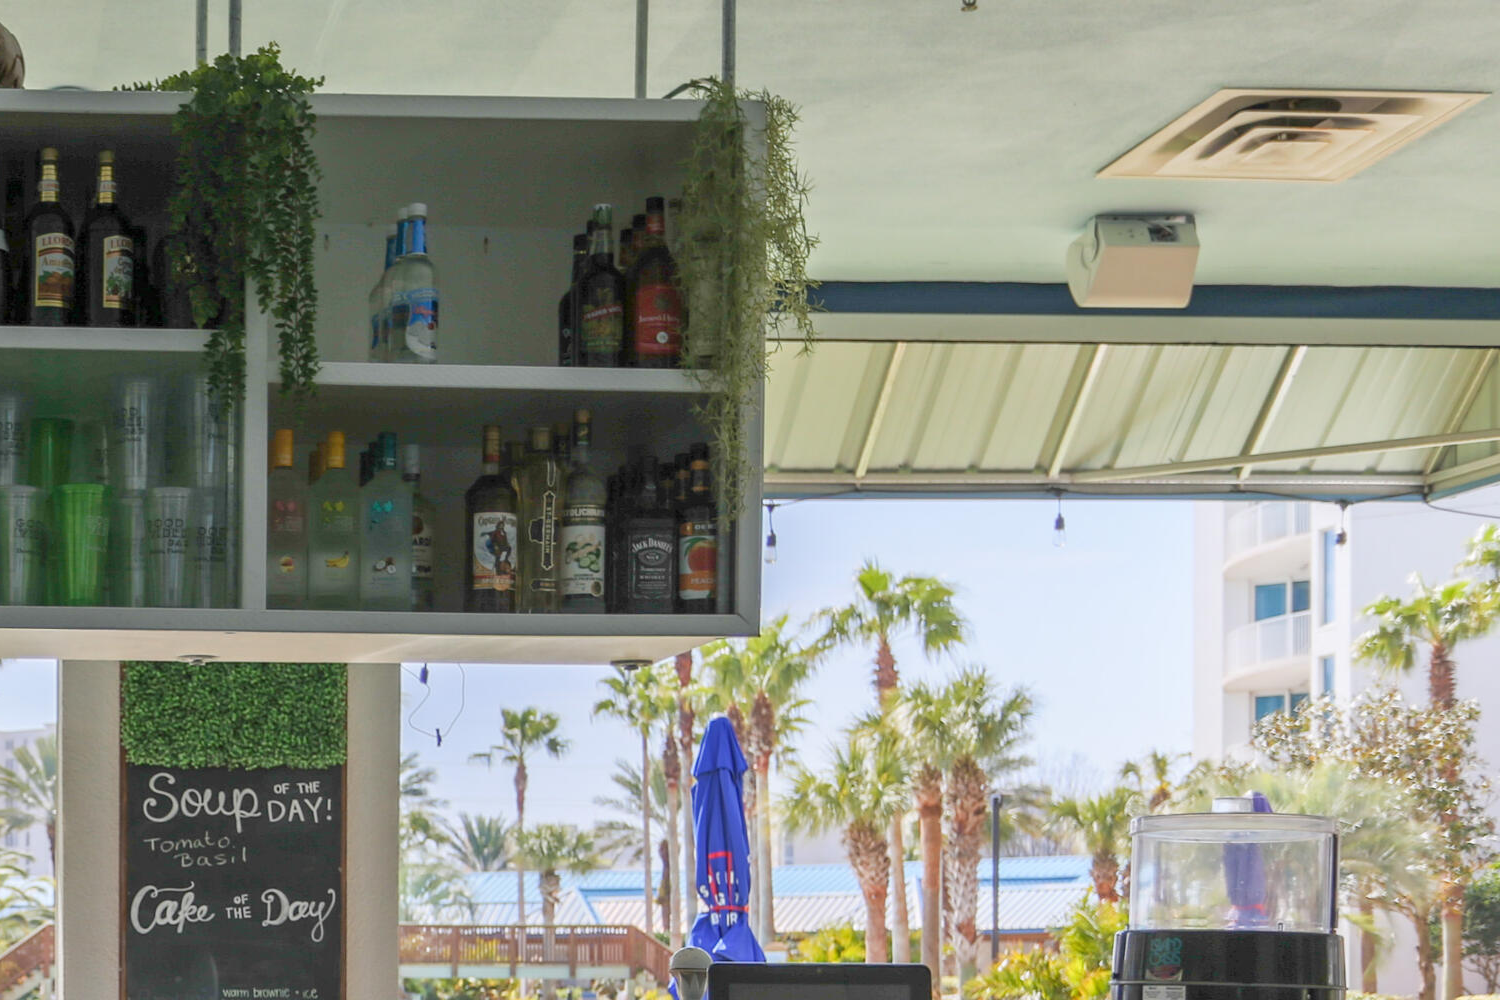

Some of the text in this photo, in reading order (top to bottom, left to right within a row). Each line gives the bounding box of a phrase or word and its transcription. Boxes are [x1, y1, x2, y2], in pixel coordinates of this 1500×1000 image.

[143, 772, 321, 834] Soup OF THE
[267, 797, 332, 823] DAY!
[173, 847, 246, 868] Basil
[130, 882, 336, 942] Cake OF THE Day
[222, 988, 319, 999] warm brownie ice
